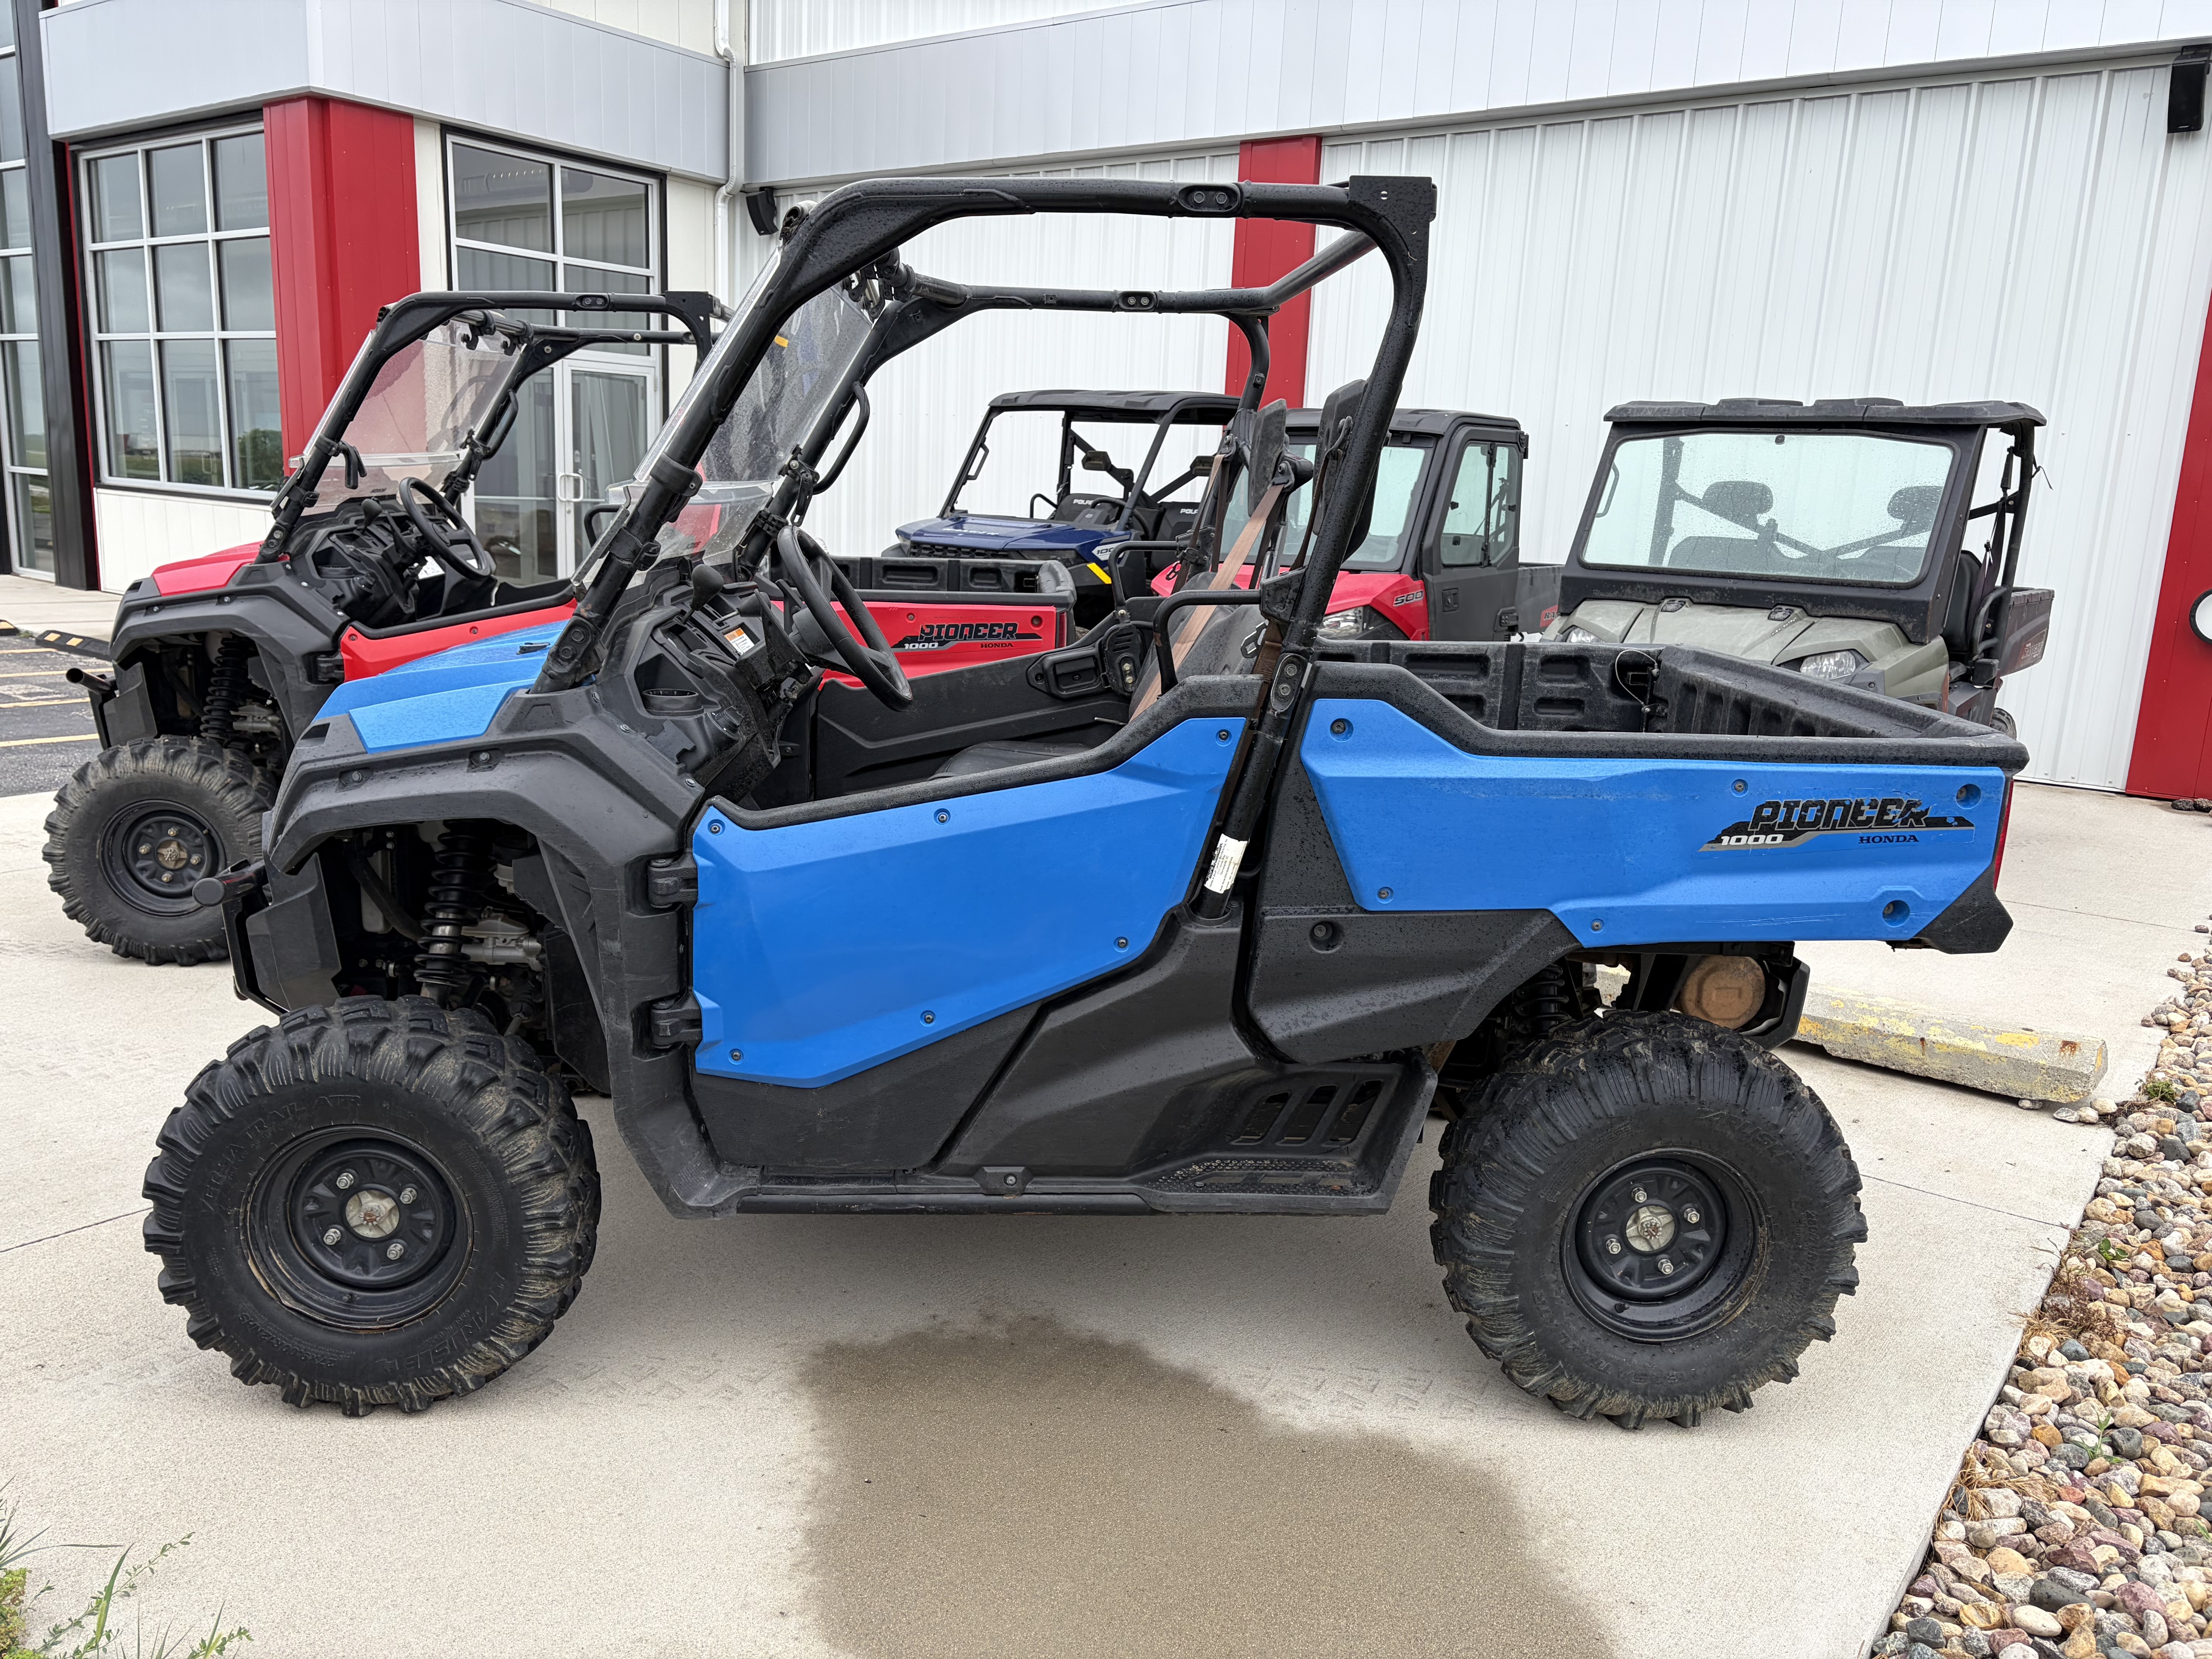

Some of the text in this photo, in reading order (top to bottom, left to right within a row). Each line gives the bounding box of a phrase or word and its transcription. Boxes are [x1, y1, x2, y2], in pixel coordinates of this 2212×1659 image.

[1393, 589, 1424, 606] 500
[918, 622, 1018, 641] PIONEER
[1748, 798, 1929, 831] PIONEER
[1721, 834, 1783, 846] 1000
[1858, 834, 1920, 845] HONDA
[402, 1294, 505, 1374] CARLISLE
